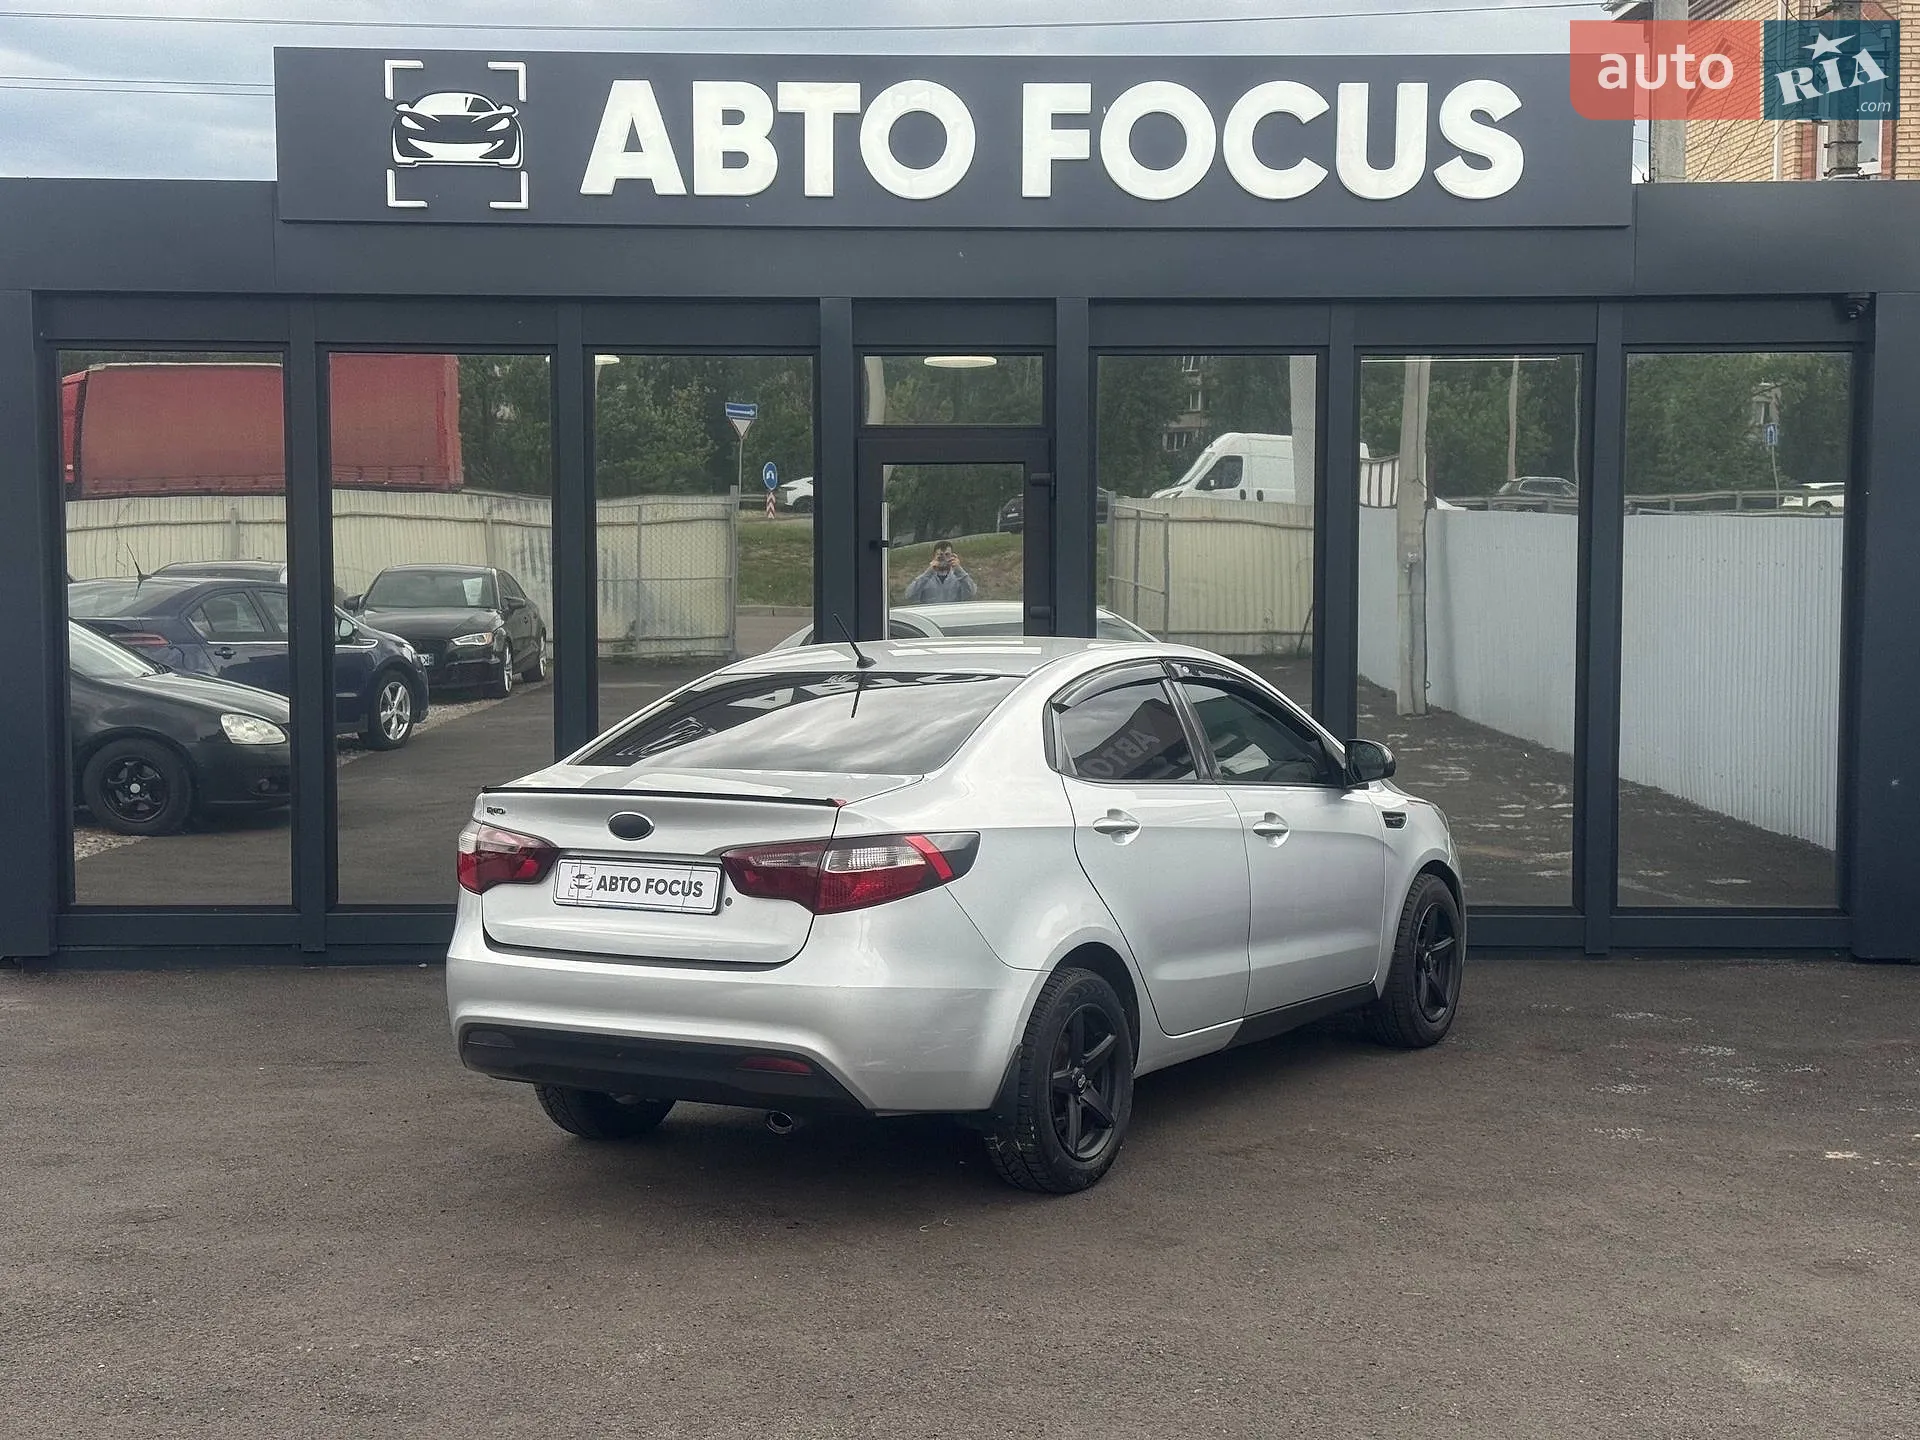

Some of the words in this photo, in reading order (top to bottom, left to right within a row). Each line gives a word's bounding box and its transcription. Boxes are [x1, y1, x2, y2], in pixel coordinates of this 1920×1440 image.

[580, 79, 976, 199] АВТО
[1021, 80, 1525, 201] FOCUS
[596, 874, 642, 893] АВТО
[644, 878, 703, 898] FOCUS
